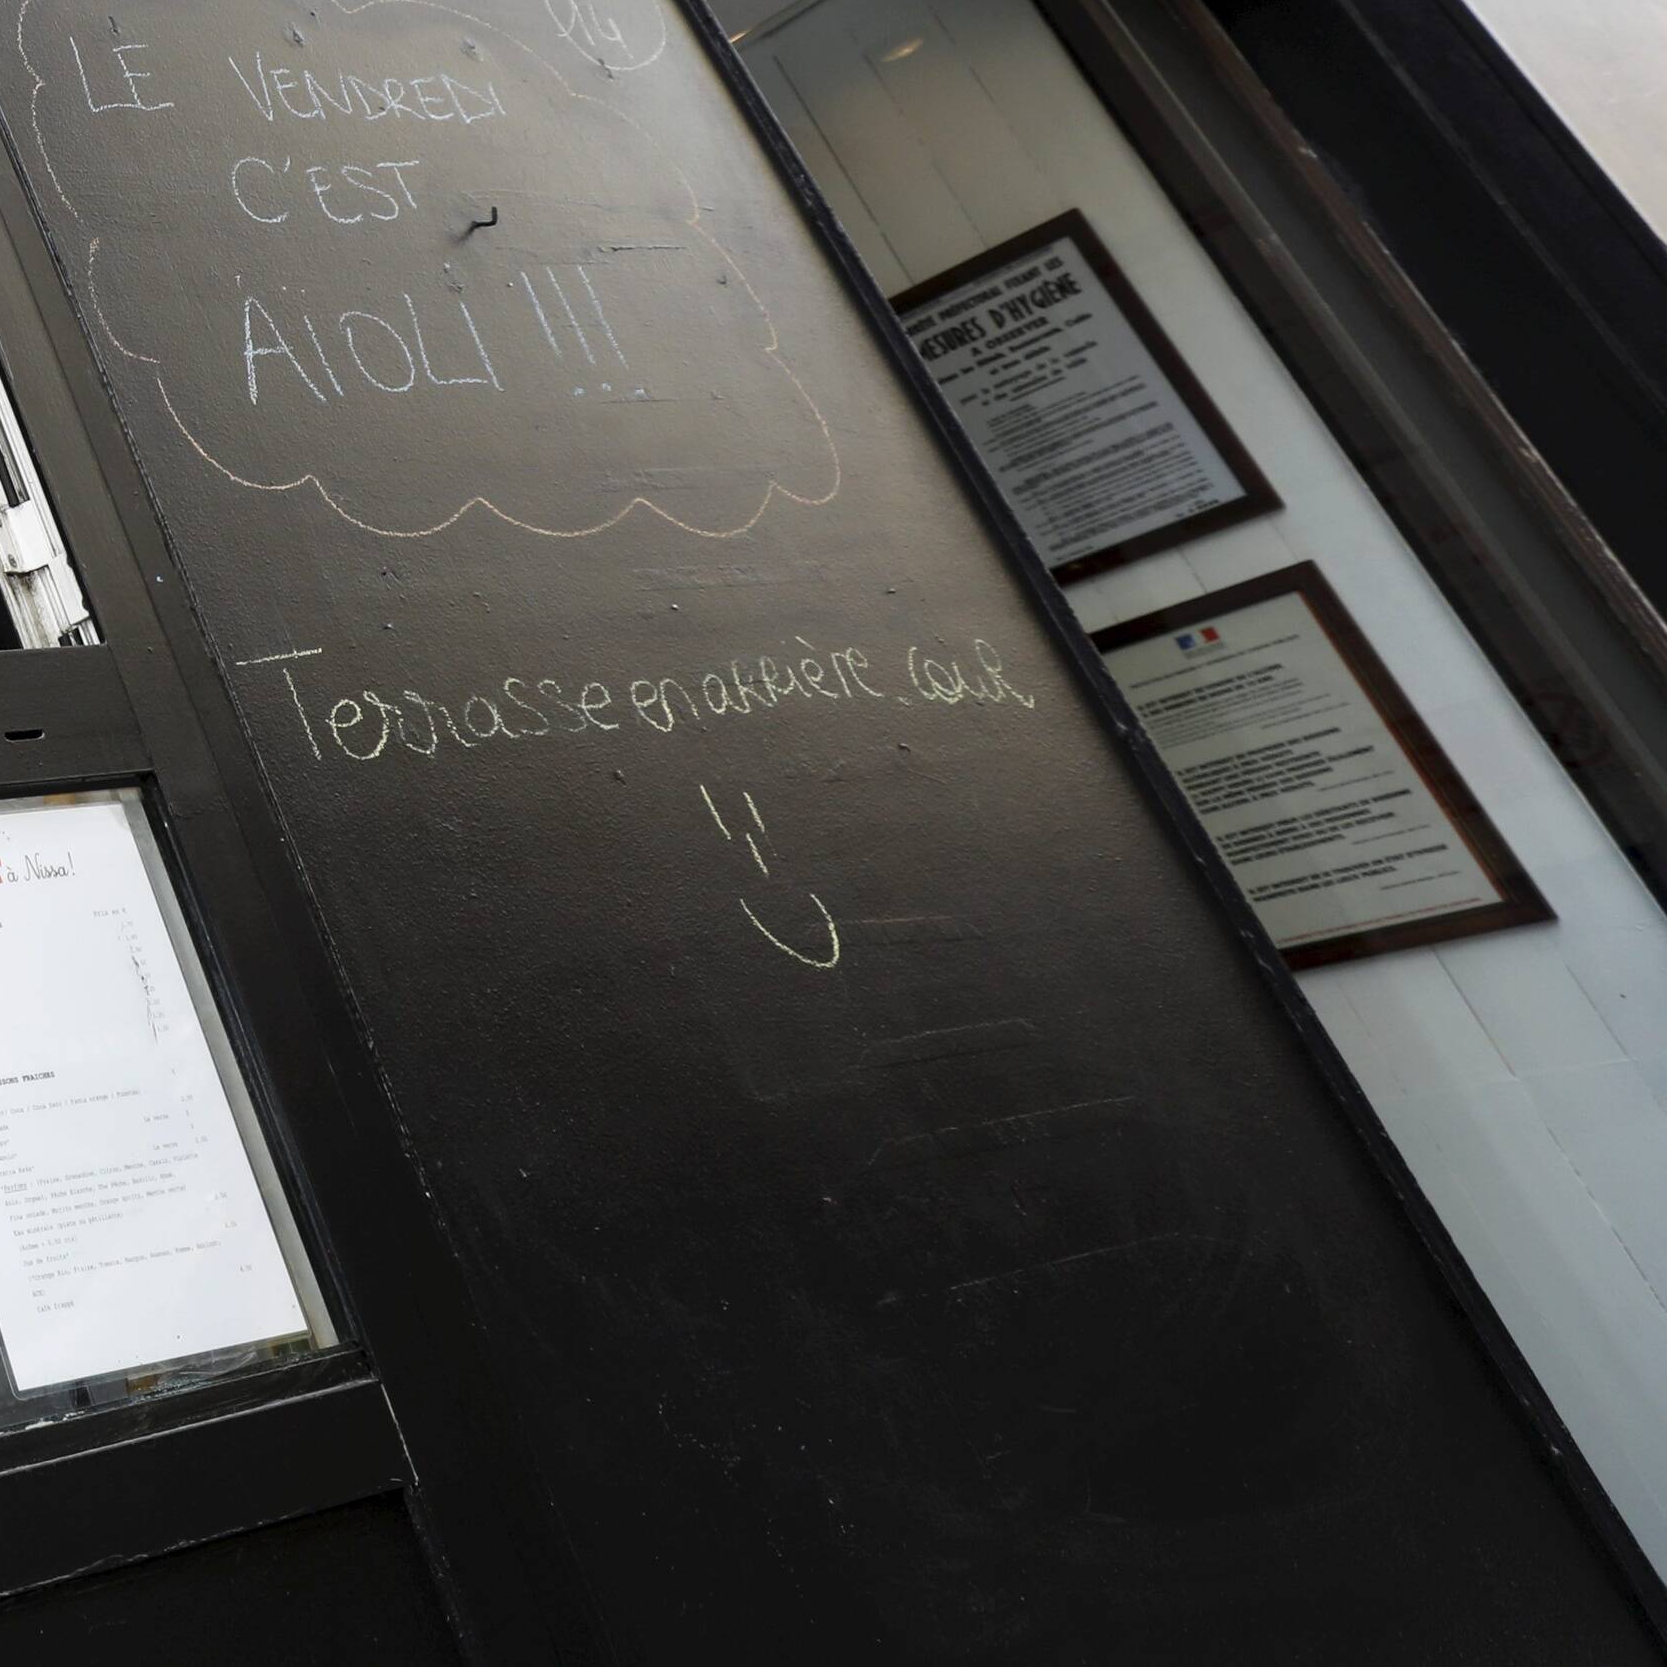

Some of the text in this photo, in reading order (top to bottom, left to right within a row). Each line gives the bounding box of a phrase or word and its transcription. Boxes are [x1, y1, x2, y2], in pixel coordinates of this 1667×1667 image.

[69, 34, 508, 125] LE VENDREDI
[231, 155, 420, 224] C'EST
[236, 647, 619, 760] Terrasse
[7, 867, 18, 883] à
[23, 851, 76, 881] Nissa!
